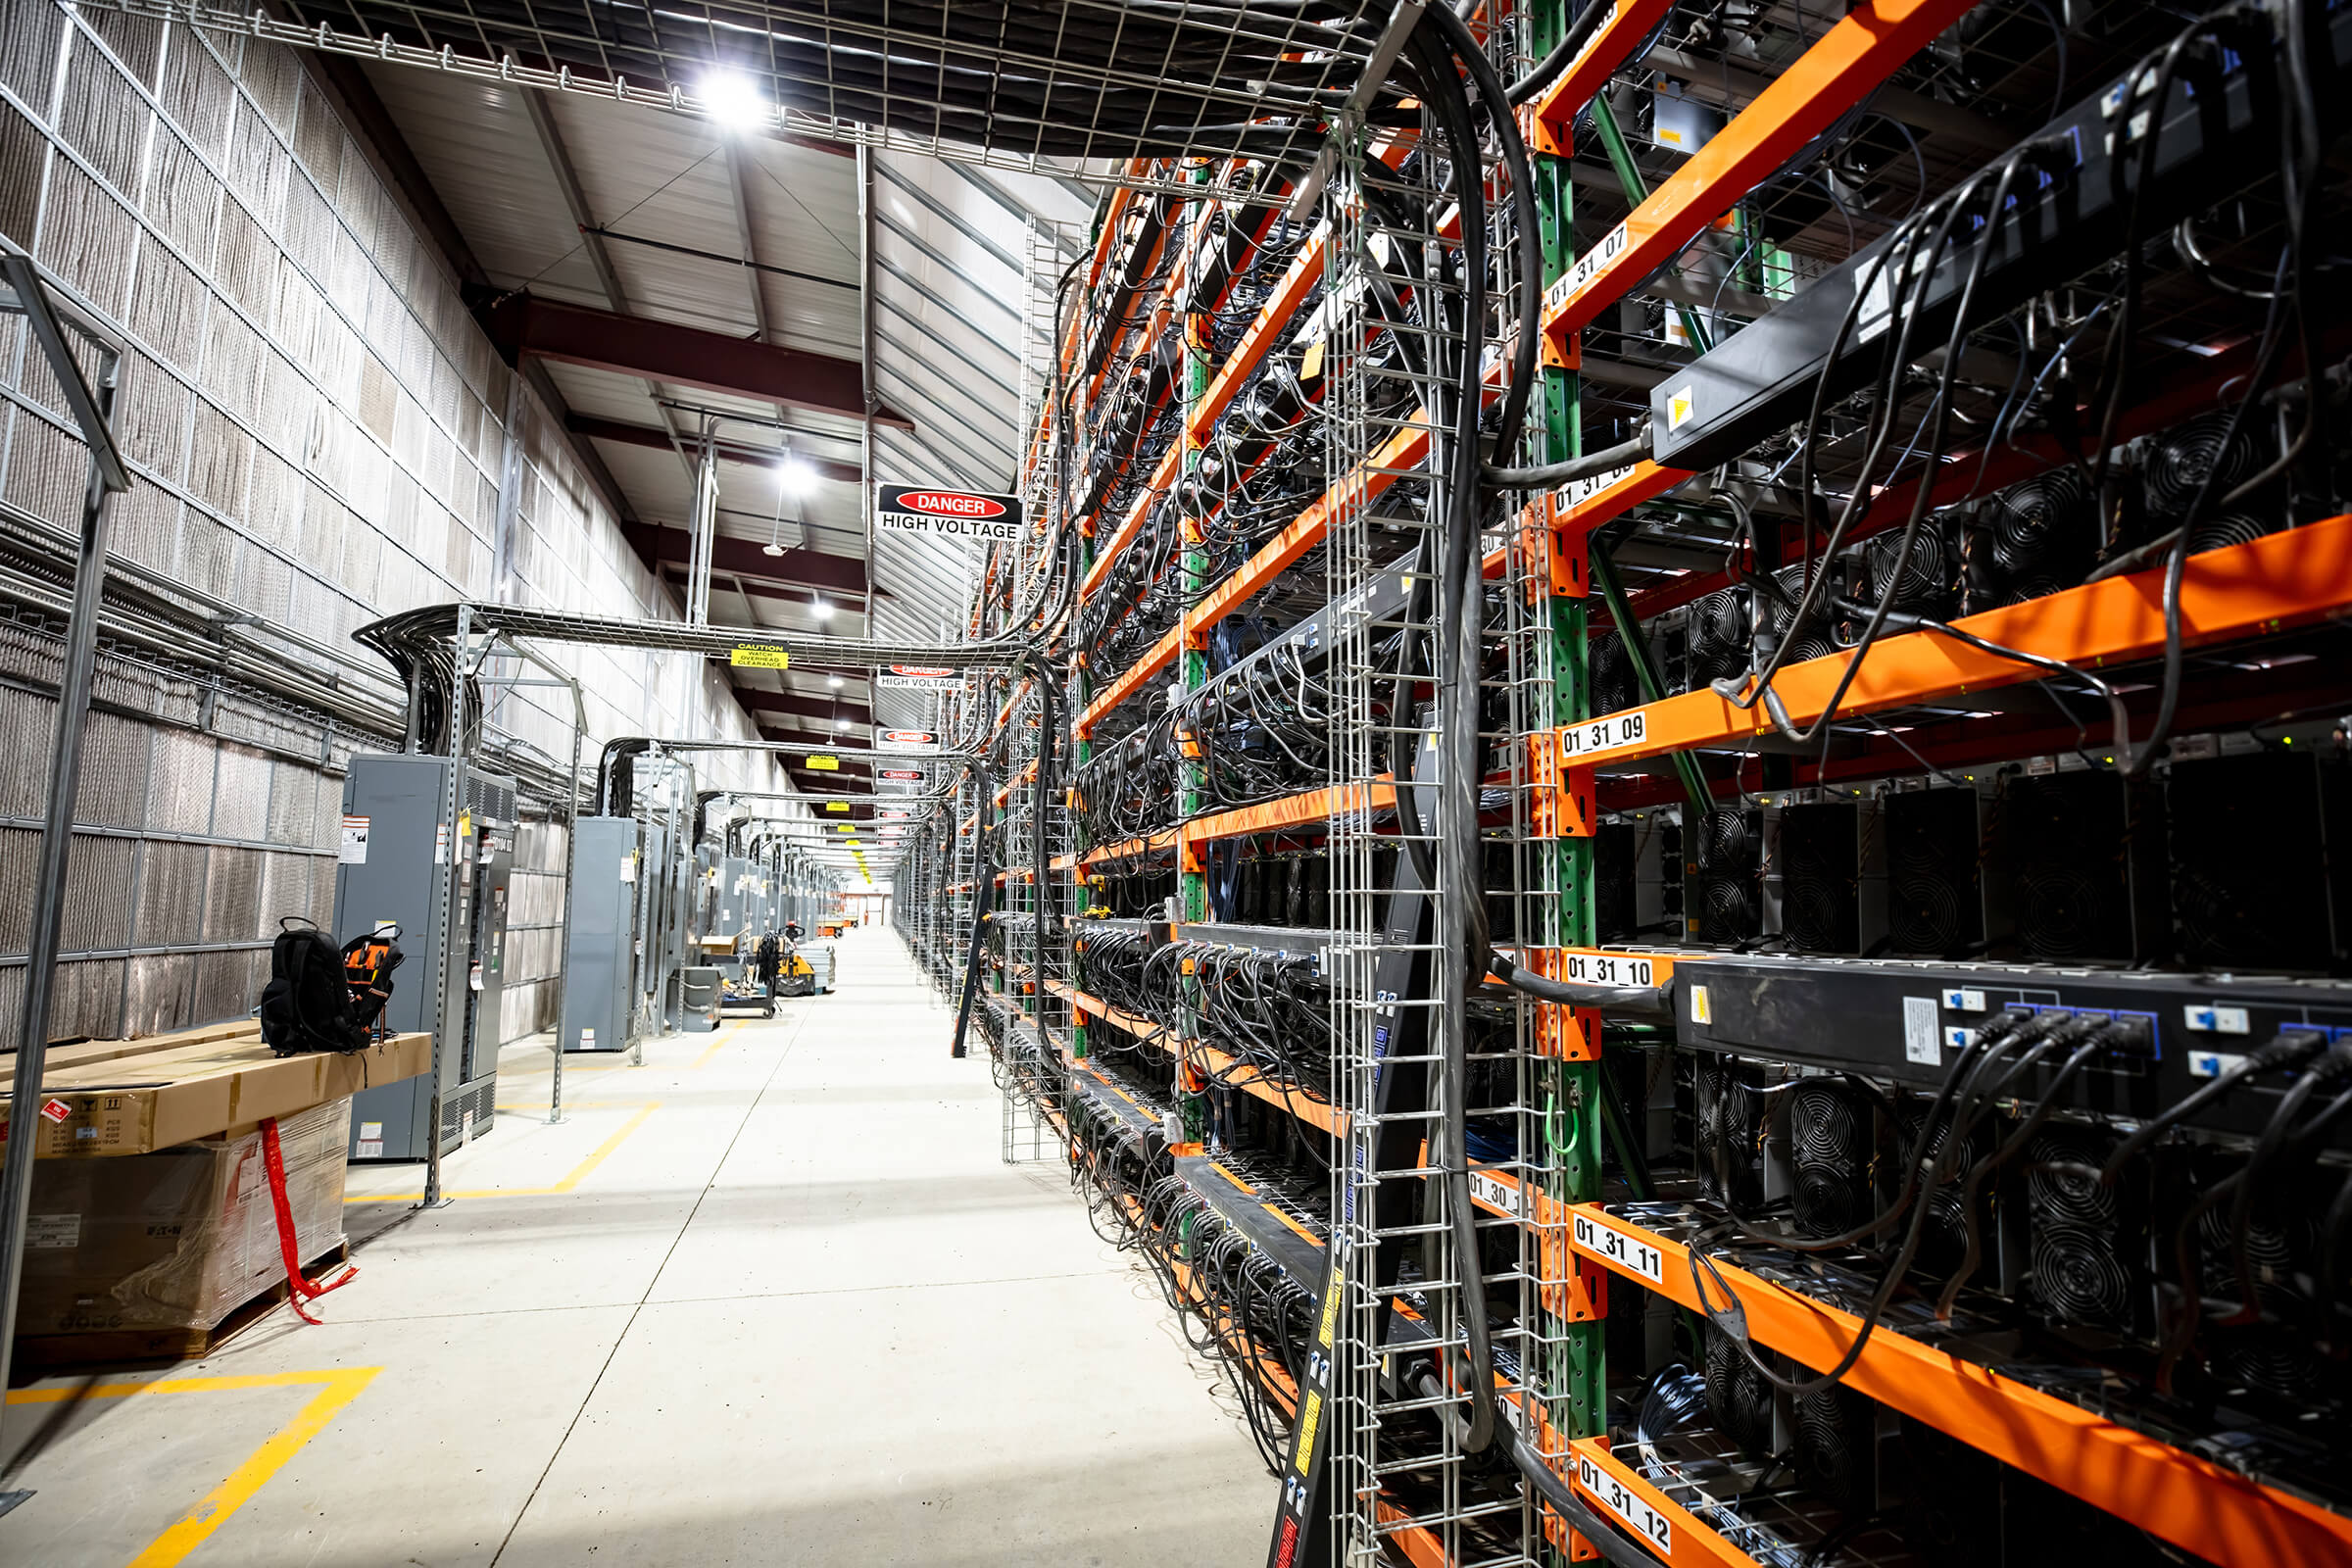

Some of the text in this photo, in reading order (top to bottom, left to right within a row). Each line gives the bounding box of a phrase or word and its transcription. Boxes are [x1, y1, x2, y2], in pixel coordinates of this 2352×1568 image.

[1551, 225, 1625, 307] 01_31_07
[917, 494, 986, 514] DANGER
[882, 514, 1017, 539] HIGH VOLTAGE
[737, 643, 784, 652] CAUTION
[882, 677, 961, 688] HIGH VOLTAGE
[1563, 715, 1643, 754] 01_31_09
[1568, 956, 1650, 986] 01_31_10
[1470, 1173, 1529, 1217] 01_30_1
[1577, 1218, 1659, 1277] 01_31_11
[1581, 1458, 1669, 1547] 01_31_12
